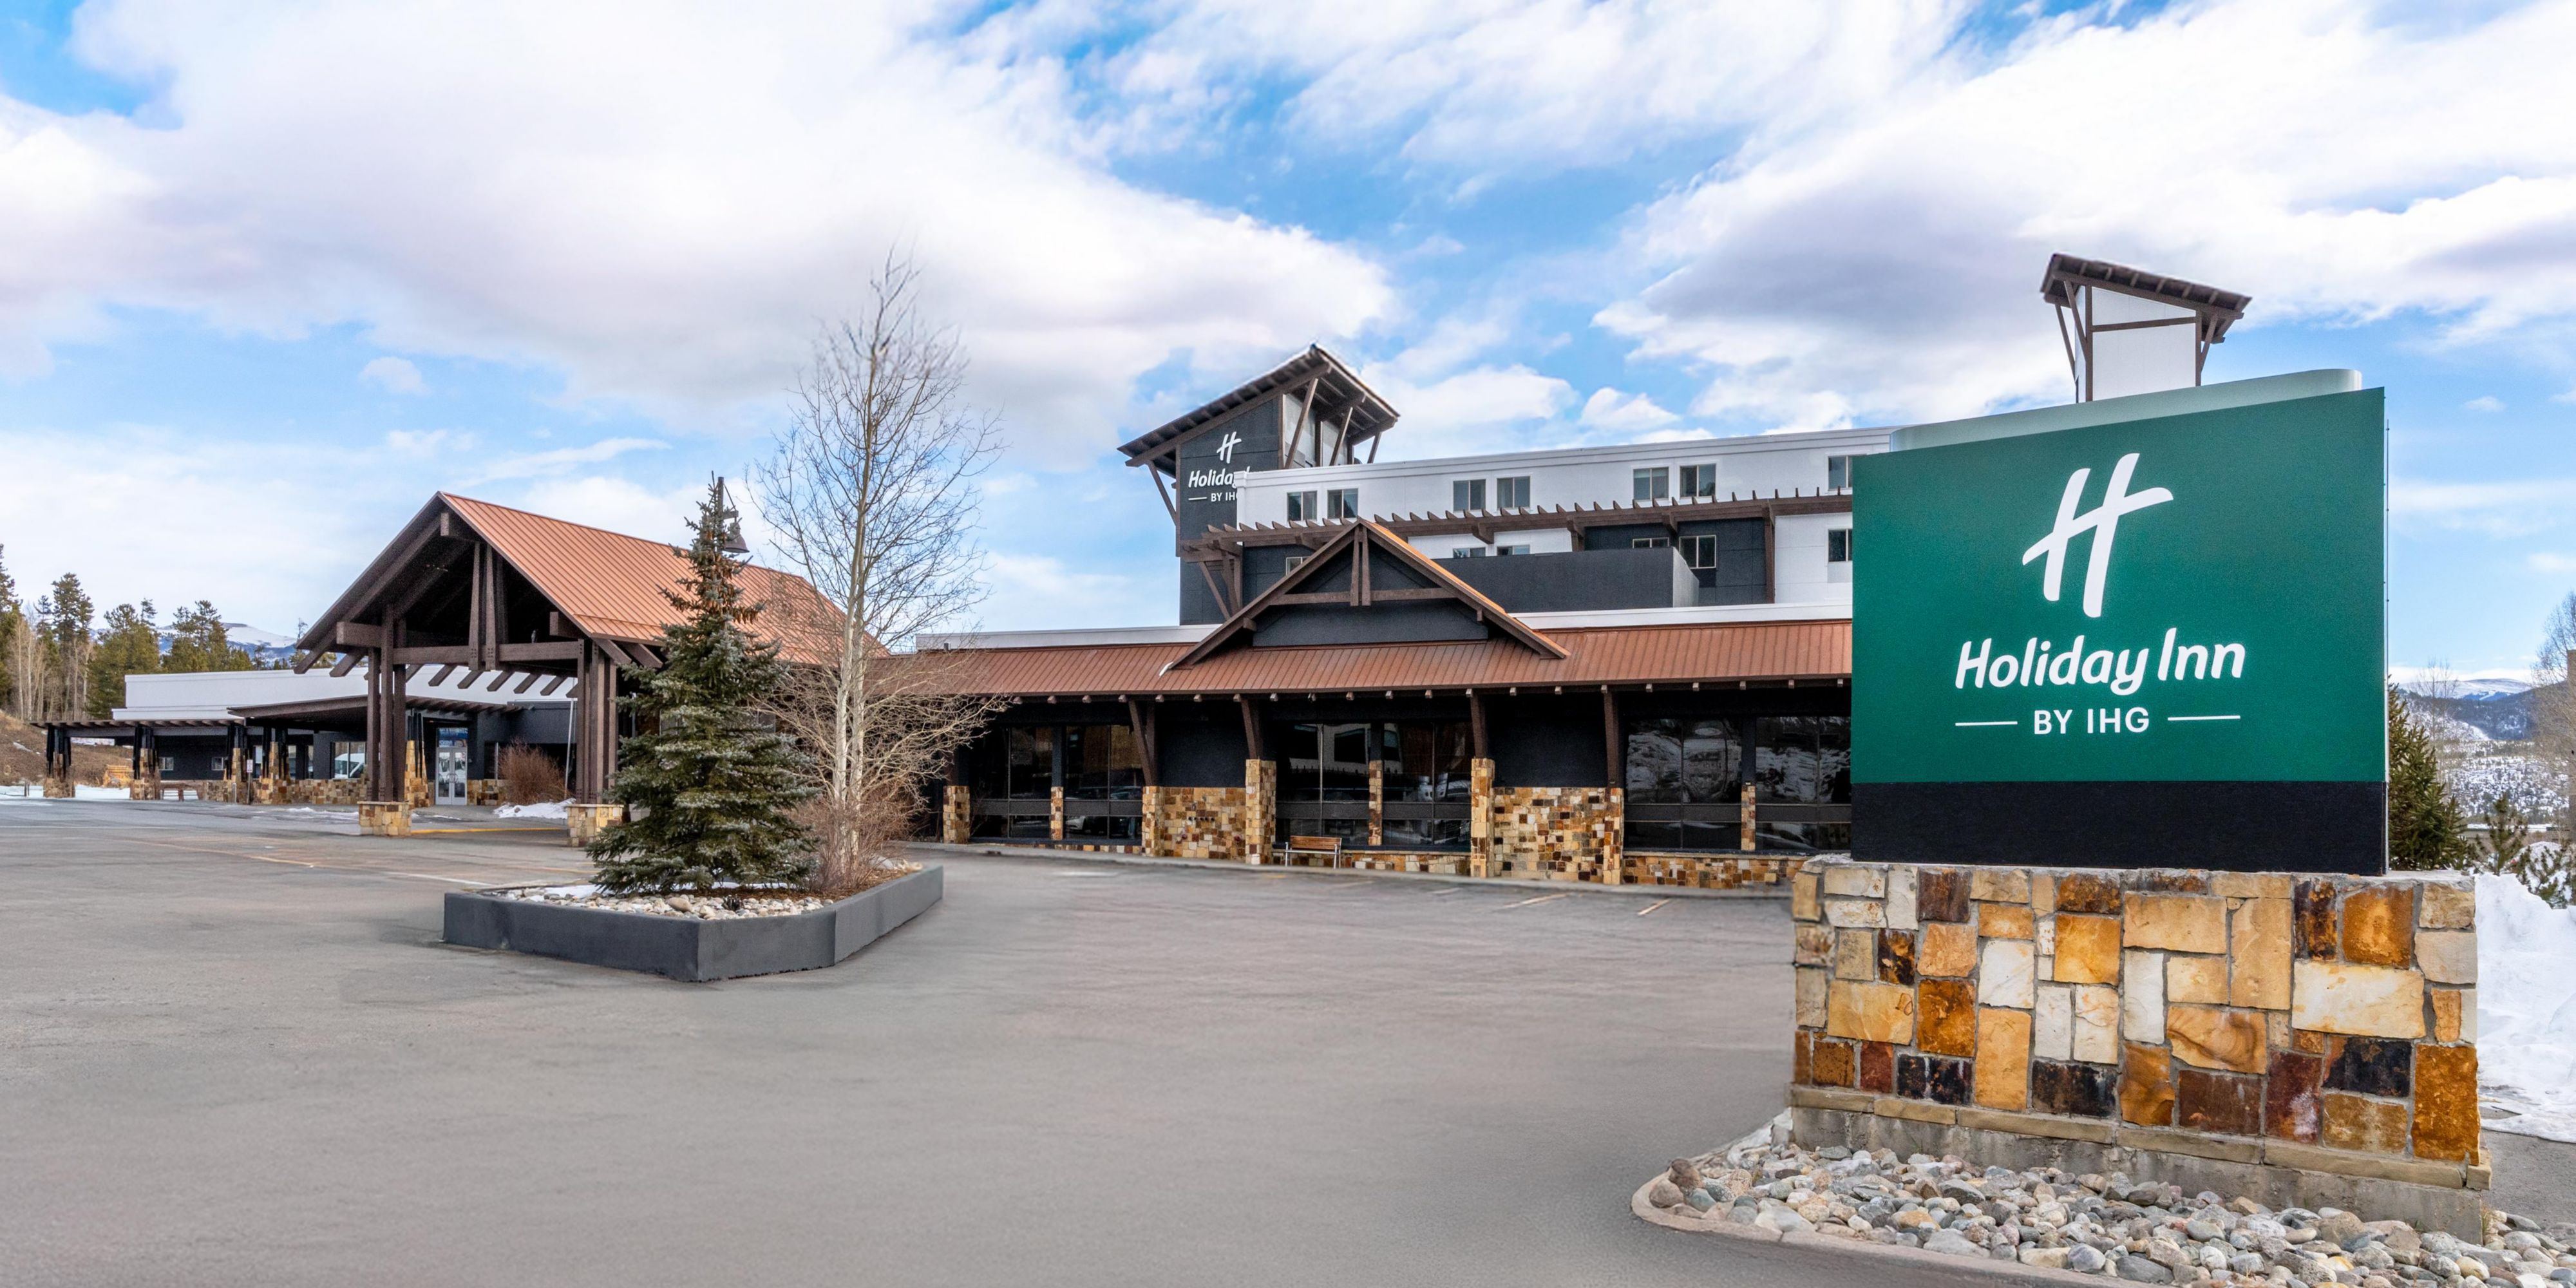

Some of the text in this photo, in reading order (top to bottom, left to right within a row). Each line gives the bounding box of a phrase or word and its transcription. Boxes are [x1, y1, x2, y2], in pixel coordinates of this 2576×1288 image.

[1211, 491, 1237, 502] BY IH
[2022, 453, 2174, 618] H
[1955, 627, 2246, 696] Holiday Inn
[2034, 707, 2150, 735] BY IHG
